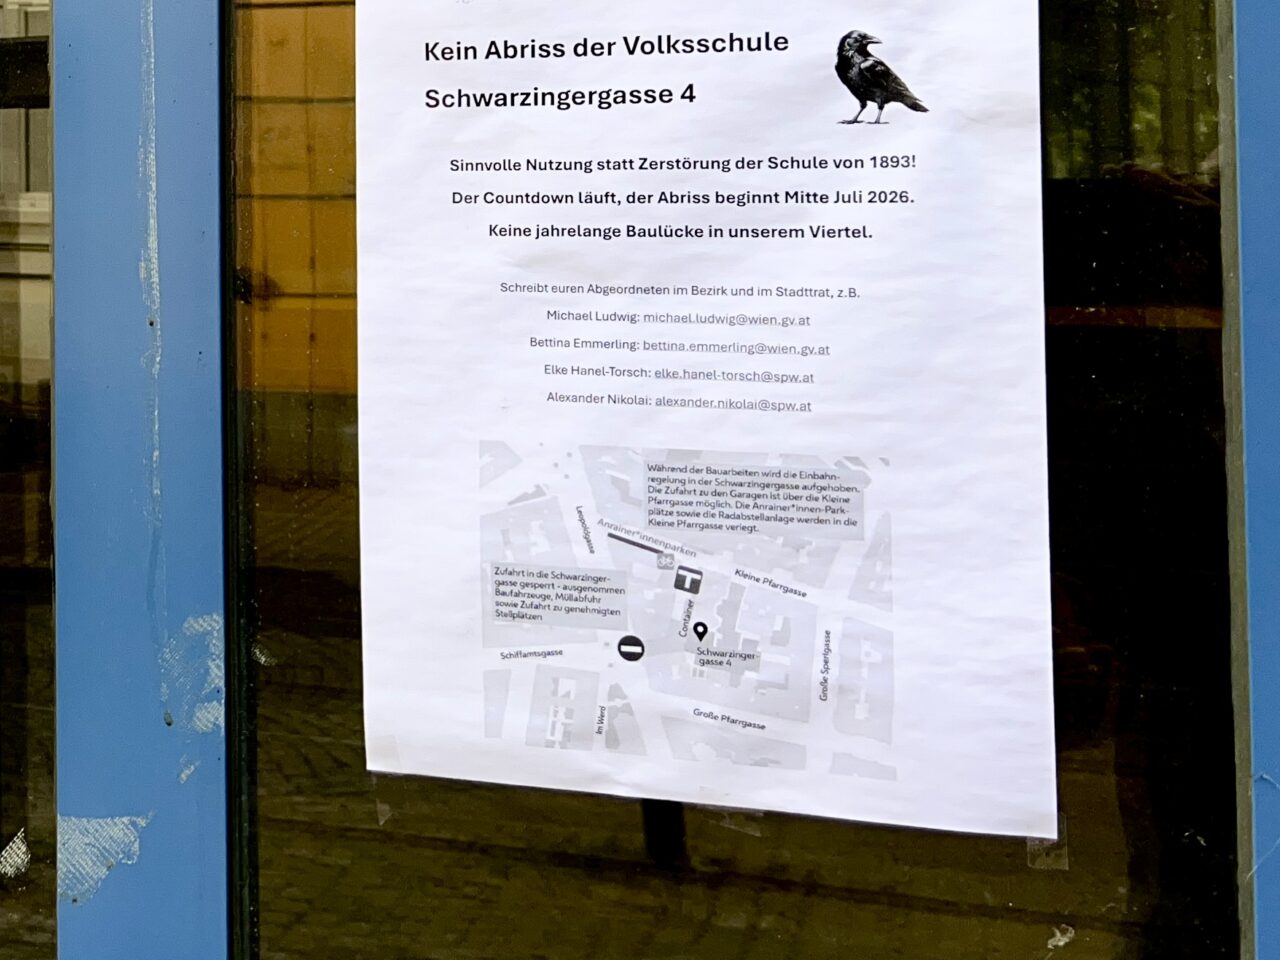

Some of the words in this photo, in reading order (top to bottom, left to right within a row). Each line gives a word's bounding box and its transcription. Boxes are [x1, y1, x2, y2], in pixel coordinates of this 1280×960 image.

[424, 41, 477, 61] Kein
[485, 39, 566, 59] Abriss
[572, 37, 617, 57] der
[621, 32, 789, 55] Volksschule
[424, 88, 673, 110] Schwarzingergasse
[679, 83, 696, 102] 4
[449, 158, 521, 171] Sinnvolle
[525, 158, 593, 173] Nutzung
[596, 158, 635, 170] statt
[637, 157, 731, 172] Zerstörung
[734, 156, 764, 169] der
[767, 155, 828, 169] Schule
[832, 158, 864, 169] von
[869, 154, 916, 168] 1893!
[452, 191, 480, 204] Der
[482, 191, 574, 204] Countdown
[578, 191, 621, 206] läuft,
[625, 191, 654, 204] der
[656, 190, 710, 204] Abriss
[714, 190, 780, 207] beginnt
[784, 190, 829, 203] Mitte
[833, 190, 862, 204] Juli
[867, 190, 914, 203] 2026.
[488, 224, 532, 236] Keine
[535, 224, 621, 240] jahrelange
[626, 224, 704, 237] Baulücke
[708, 224, 724, 238] in
[728, 227, 805, 238] unserem
[808, 225, 872, 238] Viertel.
[499, 282, 549, 293] Schreibt
[550, 285, 584, 293] euren
[586, 283, 670, 296] Abgeordneten
[672, 286, 688, 295] im
[690, 285, 728, 296] Bezirk
[730, 286, 754, 296] und
[756, 286, 772, 296] im
[775, 286, 834, 298] Stadttrat,
[836, 287, 860, 298] z.B.
[546, 309, 593, 321] Michael
[594, 311, 640, 324] Ludwig:
[642, 313, 811, 327] michael.ludwig@wien.gv.at
[529, 336, 571, 348] Bettina
[572, 337, 640, 352] Emmerling:
[642, 340, 830, 356] bettina.emmerling@wien.gv.at
[543, 363, 568, 375] Elke
[570, 365, 652, 377] Hanel-Torsch:
[653, 368, 814, 383] elke.hanel-torsch@spw.at
[545, 391, 605, 404] Alexander
[606, 393, 652, 405] Nikolai:
[654, 396, 812, 412] alexander.nikolai@spw.at
[646, 463, 688, 473] Während
[688, 465, 704, 474] der
[705, 466, 760, 477] Bauarbeiten
[760, 469, 782, 478] wird
[782, 470, 798, 479] die
[798, 470, 840, 480] Einbahn-
[646, 476, 686, 486] regelung
[687, 477, 696, 485] in
[697, 477, 713, 486] der
[714, 478, 800, 491] Schwarzingergasse
[800, 483, 861, 493] aufgehoben.
[647, 485, 663, 494] Die
[663, 486, 697, 496] Zufahrt
[709, 488, 728, 497] den
[728, 489, 769, 500] Garagen
[769, 491, 781, 500] ist
[782, 492, 804, 501] über
[804, 493, 820, 502] die
[821, 494, 851, 504] Kleine
[647, 496, 694, 508] Pfarrgasse
[695, 499, 733, 510] möglich.
[734, 501, 751, 510] Die
[647, 508, 674, 517] plätze
[675, 510, 701, 518] sowie
[701, 510, 717, 519] die
[717, 511, 795, 524] Radabstellanlage
[795, 516, 831, 524] werden
[832, 517, 842, 525] in
[842, 518, 858, 526] die
[647, 518, 675, 527] Kleine
[676, 519, 723, 531] Pfarrgasse
[493, 567, 525, 577] Zufahrt
[525, 569, 535, 578] in
[535, 569, 549, 579] die
[550, 570, 611, 584] Schwarzinger-
[734, 568, 760, 583] Kleine
[762, 577, 808, 598] Pfarrgasse
[493, 579, 518, 590] gasse
[518, 580, 555, 590] gesperrt
[562, 584, 626, 594] ausgenommen
[494, 589, 553, 602] Baufahrzeuge,
[554, 593, 602, 603] Müllabfuhr
[494, 600, 519, 609] sowie
[519, 601, 551, 610] Zufahrt
[563, 606, 620, 616] genehmigten
[678, 599, 695, 638] Container
[699, 658, 724, 667] gasse
[693, 708, 719, 721] Große
[720, 714, 766, 730] Pfarrgasse
